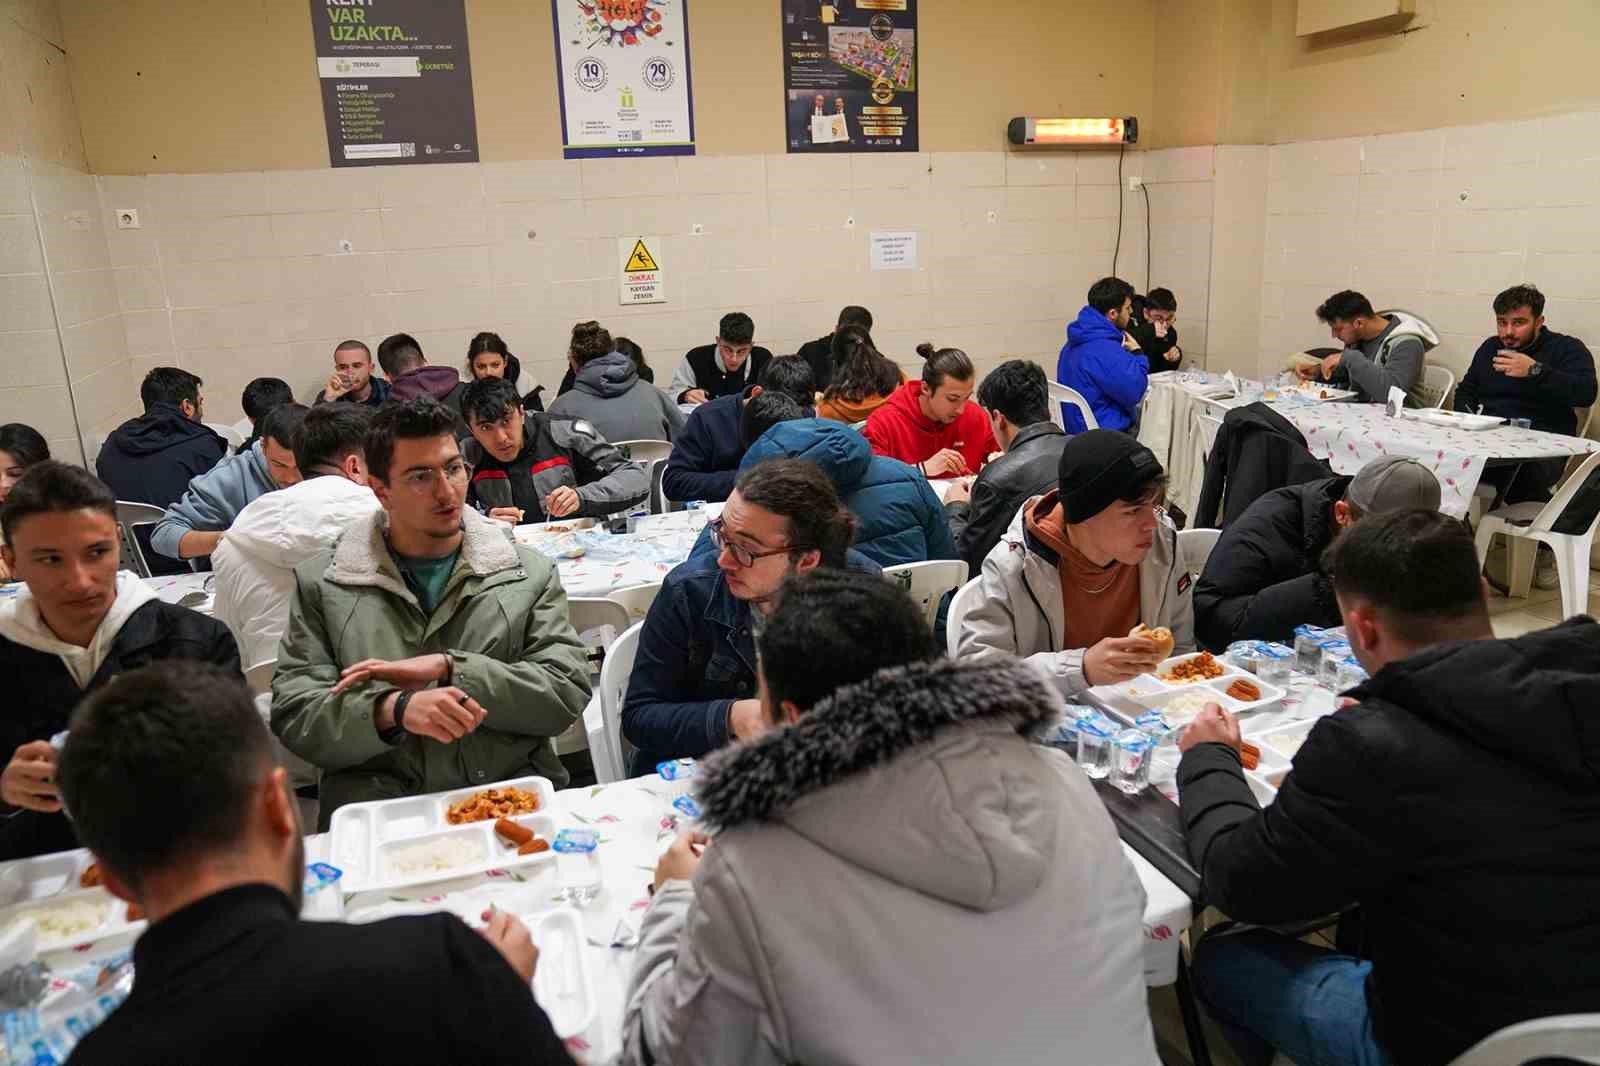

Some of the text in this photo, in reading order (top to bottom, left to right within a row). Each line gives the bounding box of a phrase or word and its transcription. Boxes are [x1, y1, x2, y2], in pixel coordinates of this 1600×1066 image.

[327, 8, 365, 23] VAR
[329, 26, 418, 41] UZAKTA...
[583, 63, 599, 78] 19
[650, 63, 667, 78] 29
